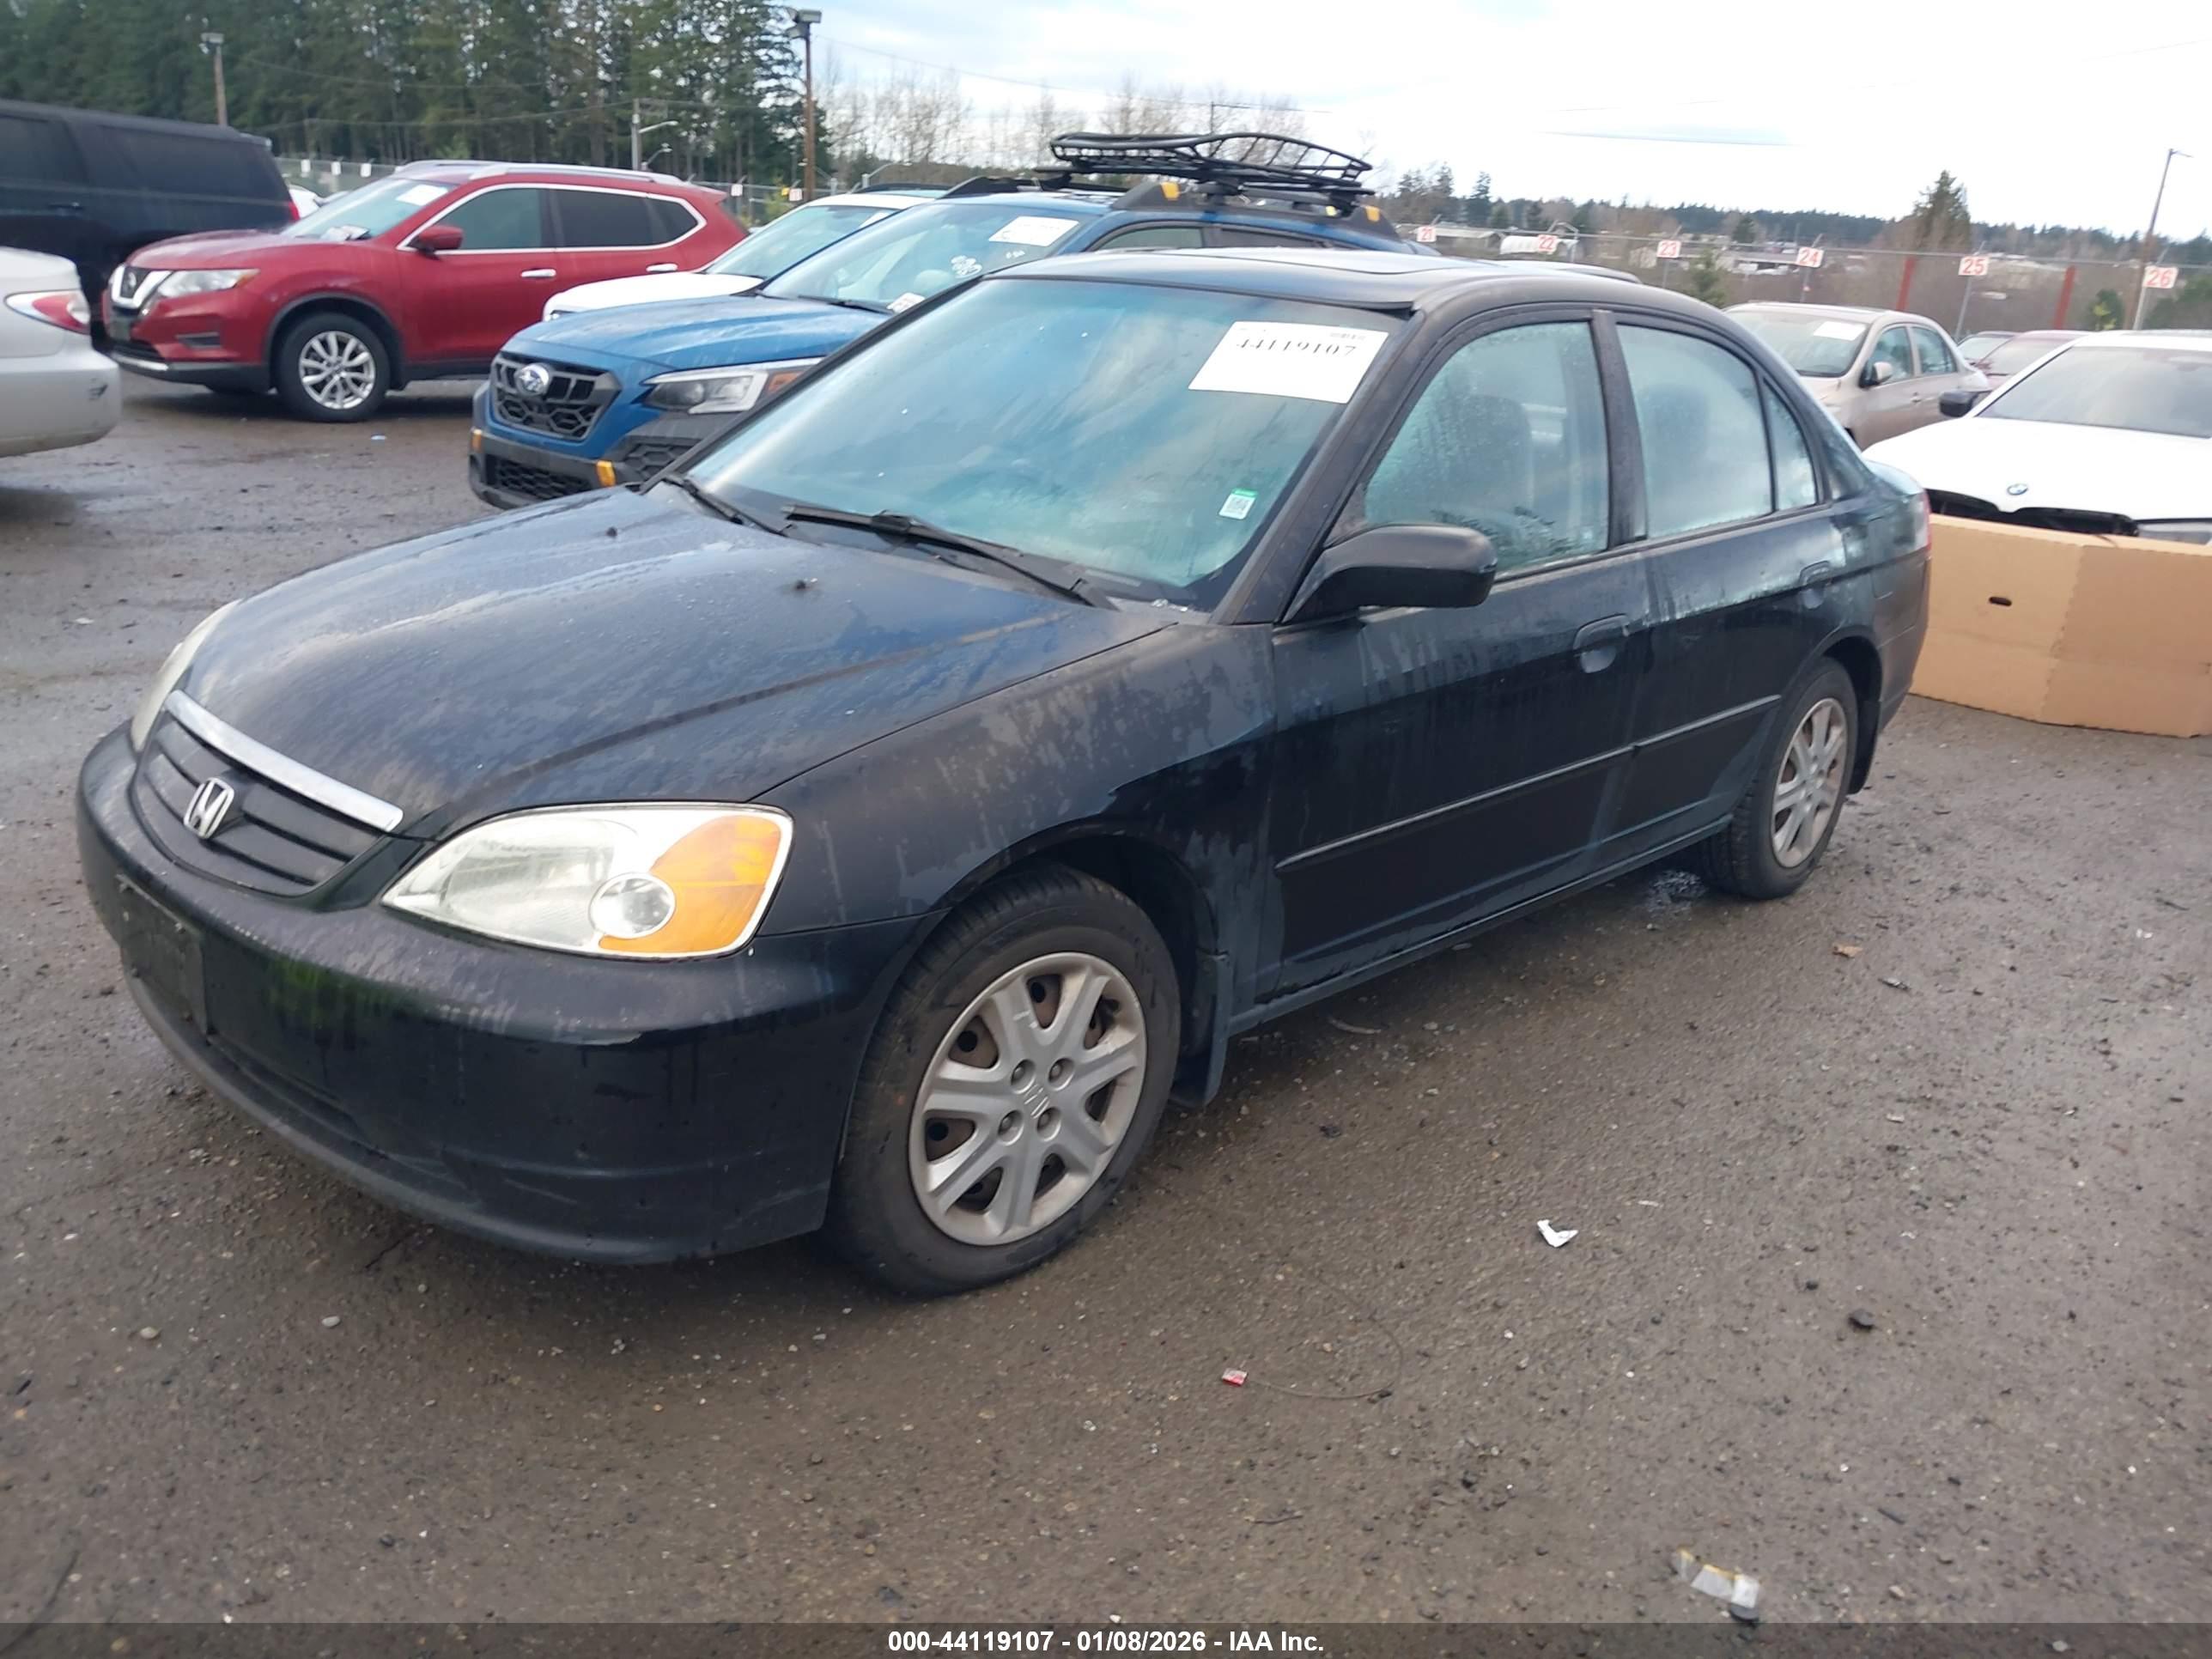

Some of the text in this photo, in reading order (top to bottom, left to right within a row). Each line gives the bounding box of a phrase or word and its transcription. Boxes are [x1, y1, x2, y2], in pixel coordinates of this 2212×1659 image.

[1539, 235, 1554, 250] 22
[1660, 241, 1678, 256] 23
[1799, 249, 1820, 264] 24
[1962, 258, 1985, 274] 25
[2147, 268, 2172, 286] 26
[1236, 338, 1357, 356] 44119107
